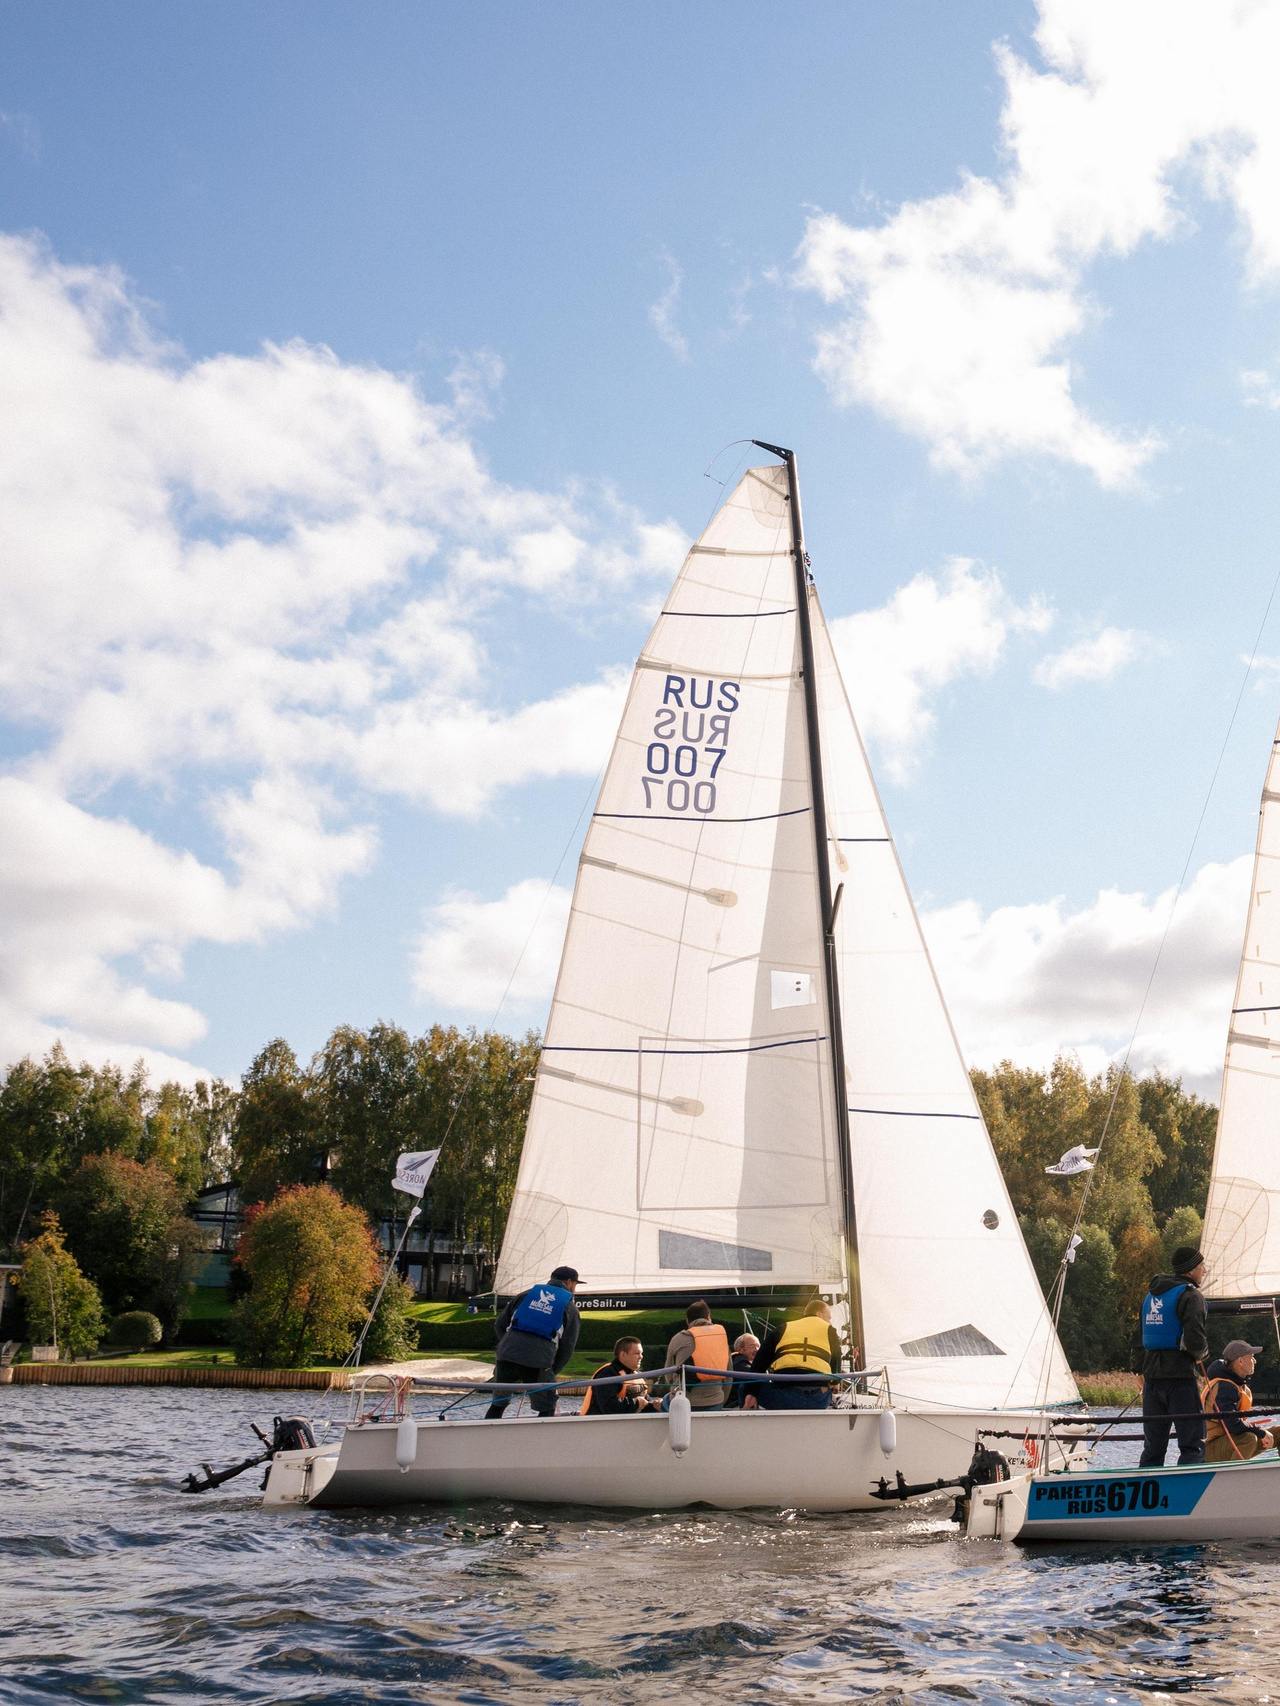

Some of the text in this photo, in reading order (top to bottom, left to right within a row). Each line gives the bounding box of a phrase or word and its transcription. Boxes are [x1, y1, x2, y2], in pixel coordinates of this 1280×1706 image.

[663, 674, 740, 713] RUS
[646, 742, 727, 779] 007
[575, 1299, 627, 1308] oreSail.ru
[1035, 1479, 1169, 1512] PAKETA 670 4
[1067, 1500, 1106, 1514] RUS
